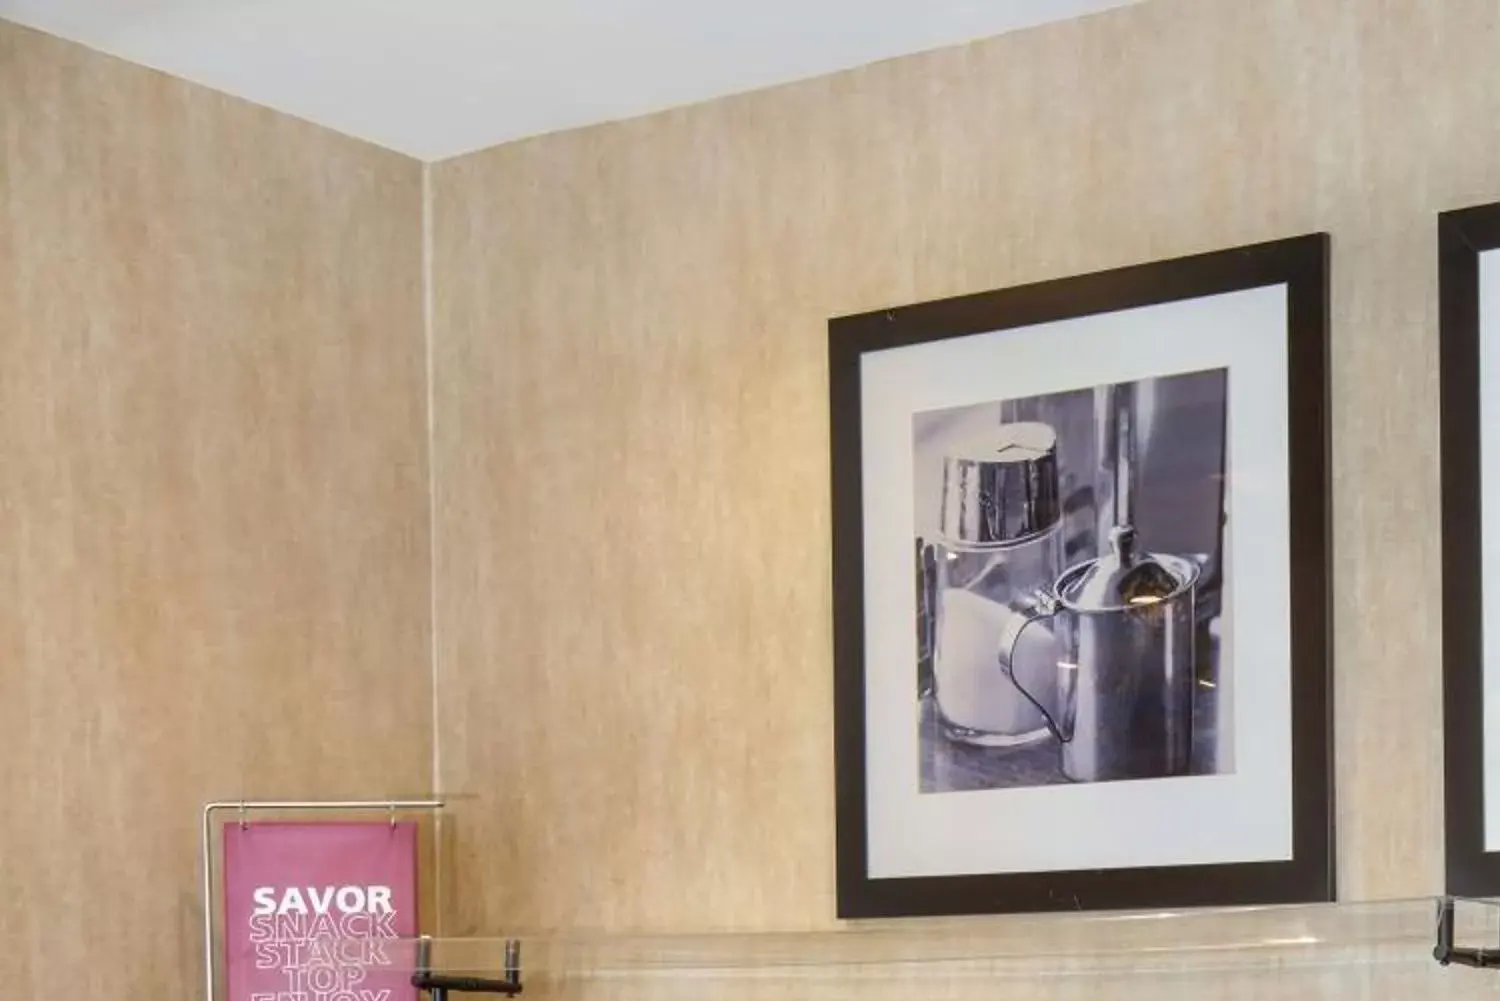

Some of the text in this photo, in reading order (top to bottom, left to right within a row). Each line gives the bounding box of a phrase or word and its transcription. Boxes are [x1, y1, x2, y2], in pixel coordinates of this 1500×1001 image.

[253, 885, 394, 915] SAVOR
[249, 910, 399, 943] SNACK
[255, 940, 392, 969] STACK
[282, 963, 367, 994] TOP
